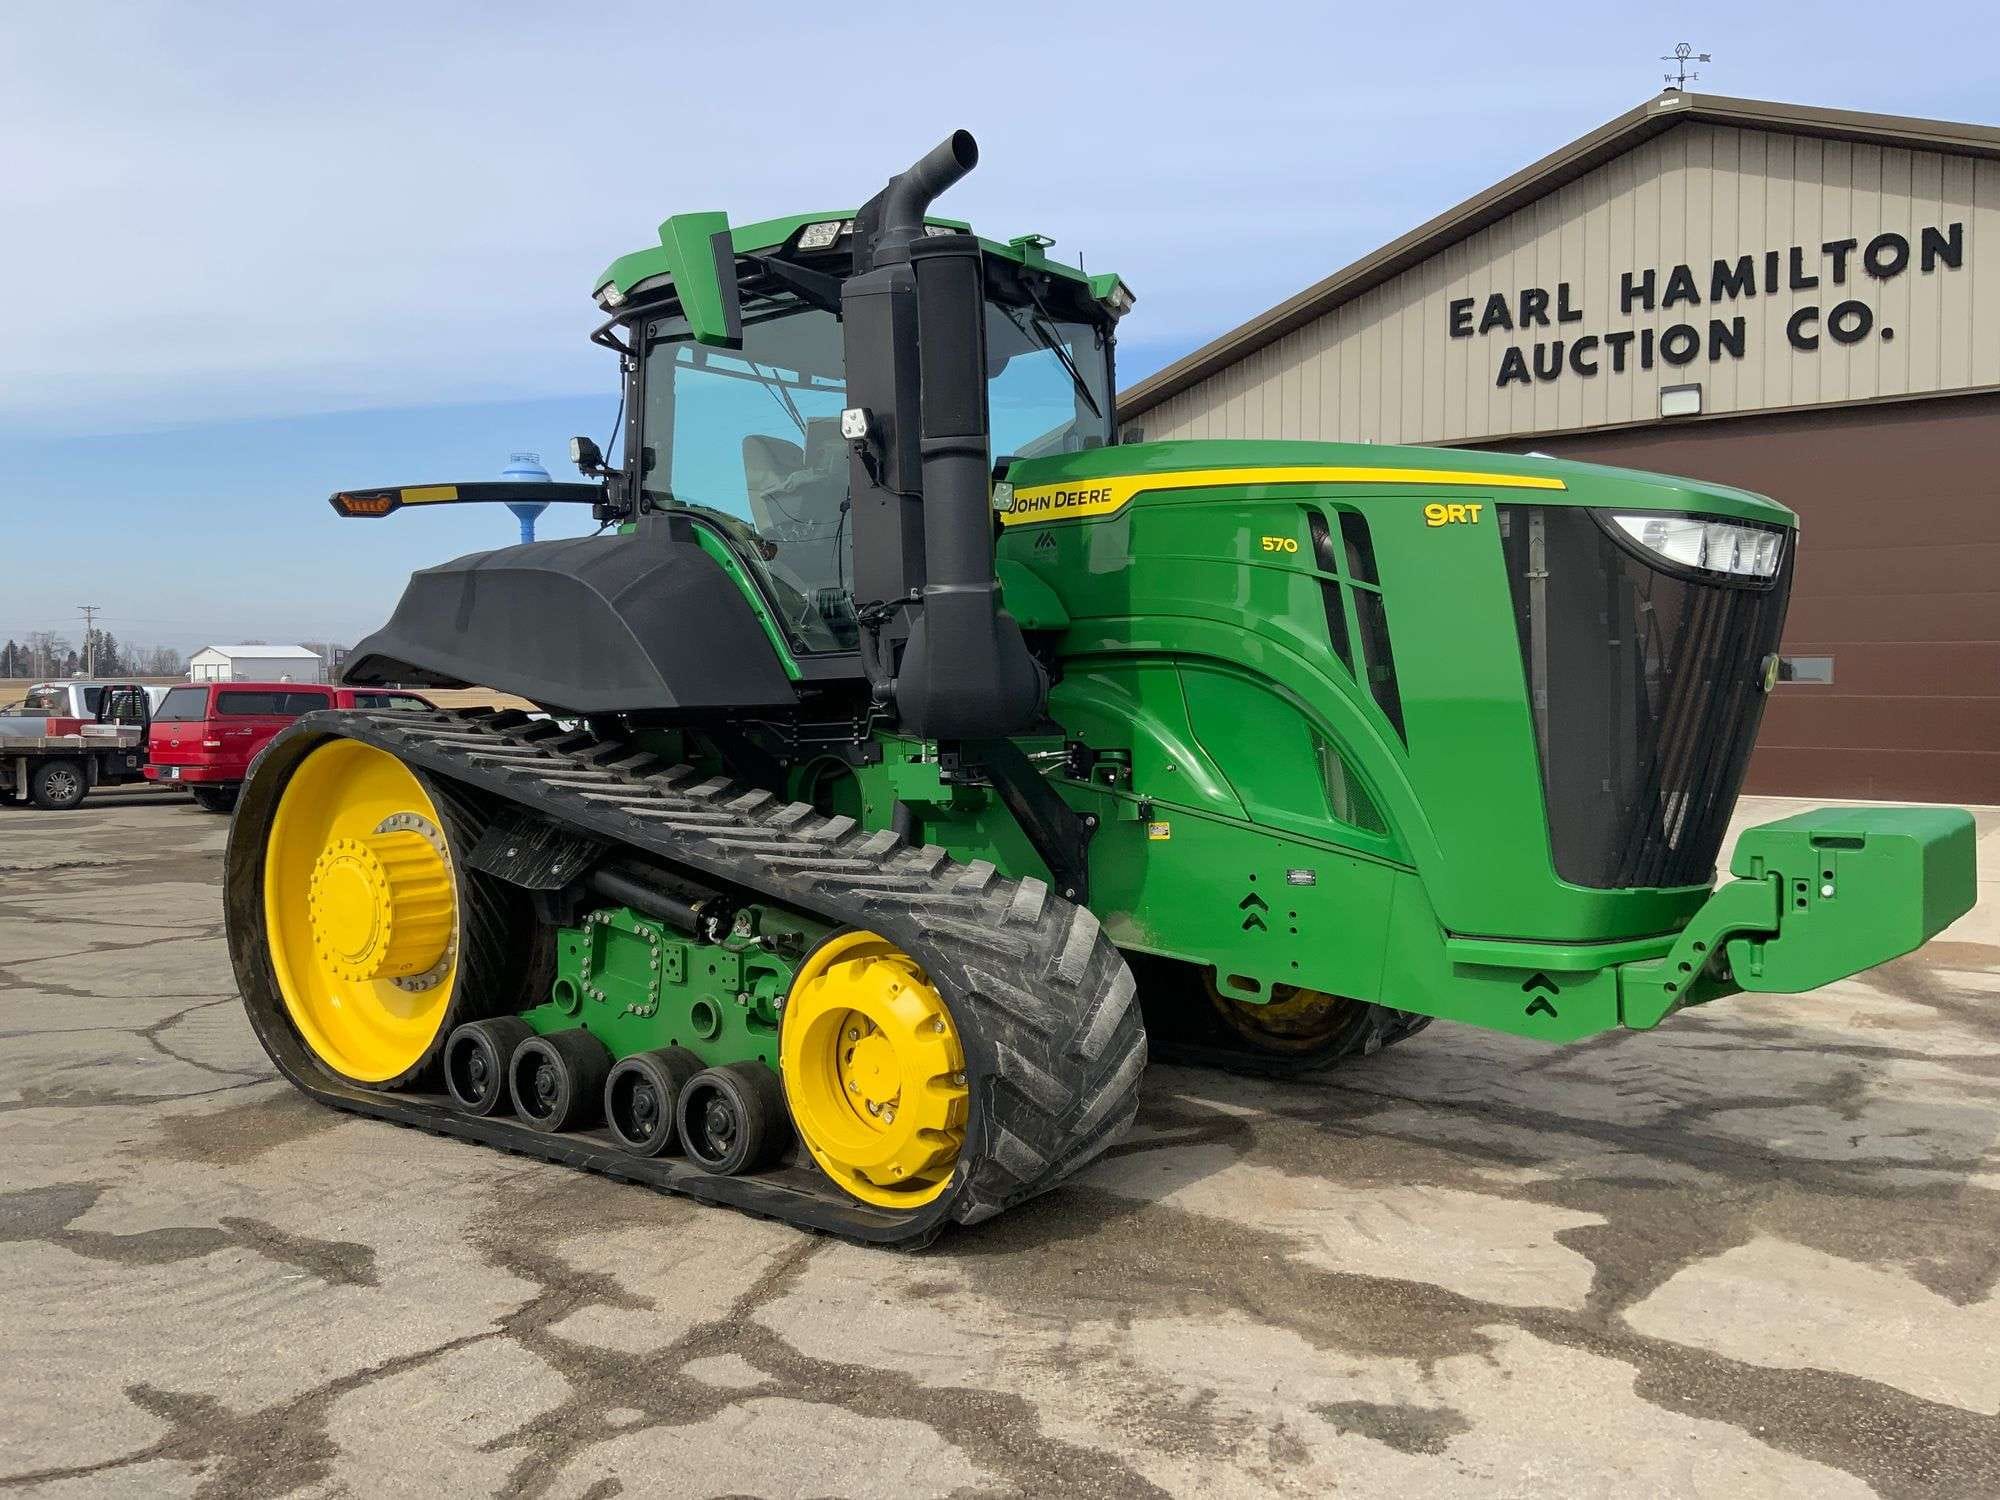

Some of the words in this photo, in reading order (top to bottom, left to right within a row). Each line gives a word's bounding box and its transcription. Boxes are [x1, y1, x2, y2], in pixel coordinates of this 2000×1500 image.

[1449, 282, 1582, 337] EARL
[1620, 222, 1962, 314] HAMILTON
[1496, 316, 1745, 387] AUCTION
[1786, 300, 1894, 350] CO.
[1009, 495, 1051, 514] JOHN
[1054, 488, 1112, 508] DEERE
[1424, 503, 1482, 527] 9RT
[1262, 536, 1298, 553] 570
